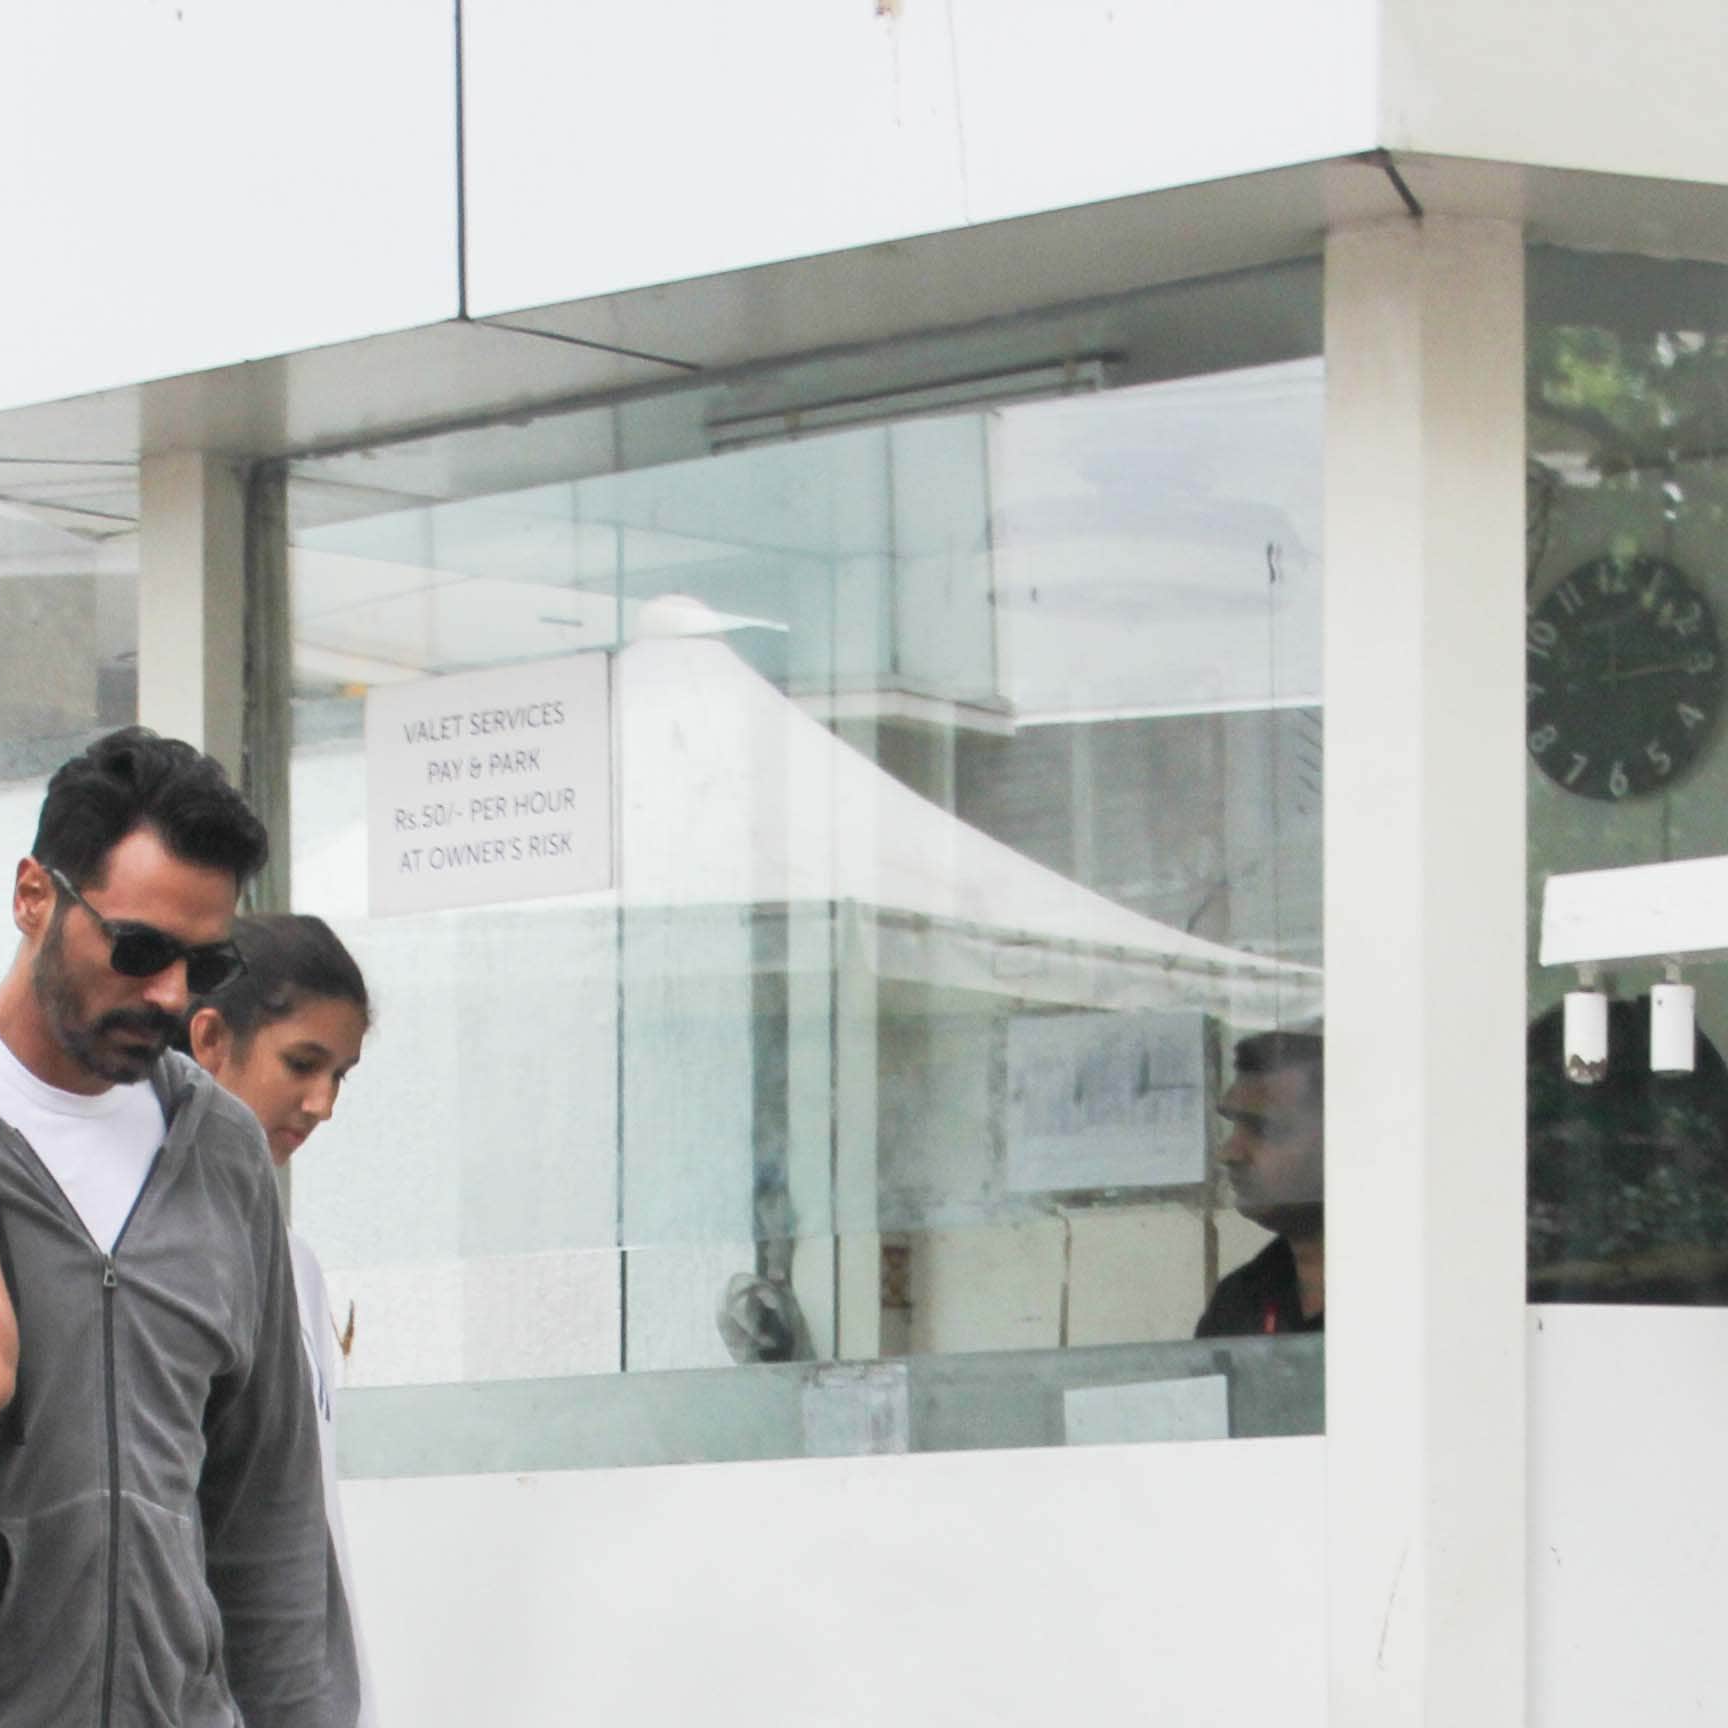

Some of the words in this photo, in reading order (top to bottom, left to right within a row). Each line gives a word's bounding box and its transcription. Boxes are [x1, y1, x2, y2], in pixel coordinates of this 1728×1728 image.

[1555, 580, 1585, 616] 11
[1525, 619, 1558, 662] 10
[403, 713, 464, 745] VALET
[469, 701, 566, 737] SERVICES
[1676, 702, 1706, 729] 4
[1528, 724, 1559, 753] 8
[1645, 737, 1672, 776] 5
[427, 758, 463, 785] PAY
[469, 756, 482, 780] &
[489, 748, 541, 779] PARK
[1564, 752, 1589, 786] 7
[1608, 759, 1629, 798] 6
[471, 794, 508, 823] PER
[514, 787, 577, 818] HOUR
[400, 848, 423, 874] AT
[428, 836, 523, 870] OWNER'S
[528, 832, 574, 859] RISK
